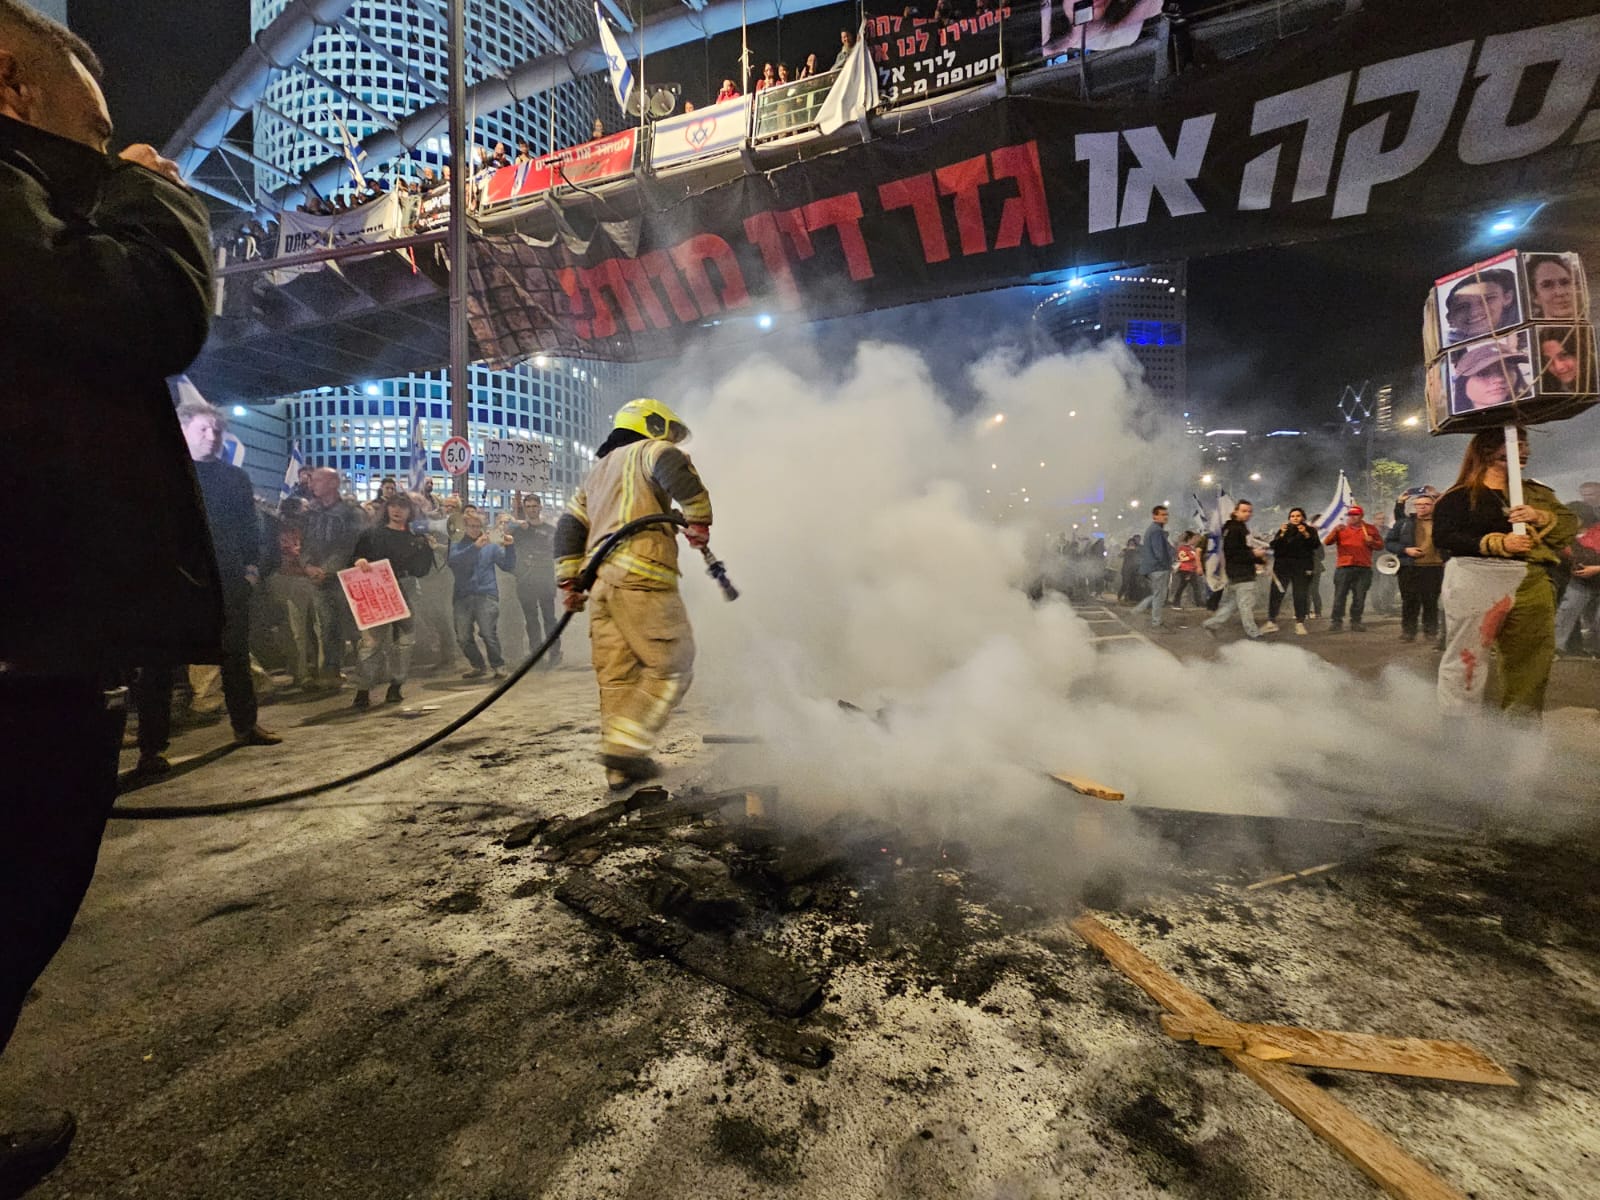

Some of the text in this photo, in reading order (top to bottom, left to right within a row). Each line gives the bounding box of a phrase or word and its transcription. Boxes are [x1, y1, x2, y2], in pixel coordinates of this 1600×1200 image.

[879, 49, 956, 86] לירי אל
[897, 28, 930, 57] לנו
[936, 52, 1002, 88] חטופה
[1074, 112, 1217, 234] או
[1237, 13, 1600, 220] סקה
[743, 191, 875, 309] דין
[878, 140, 1054, 264] גזר
